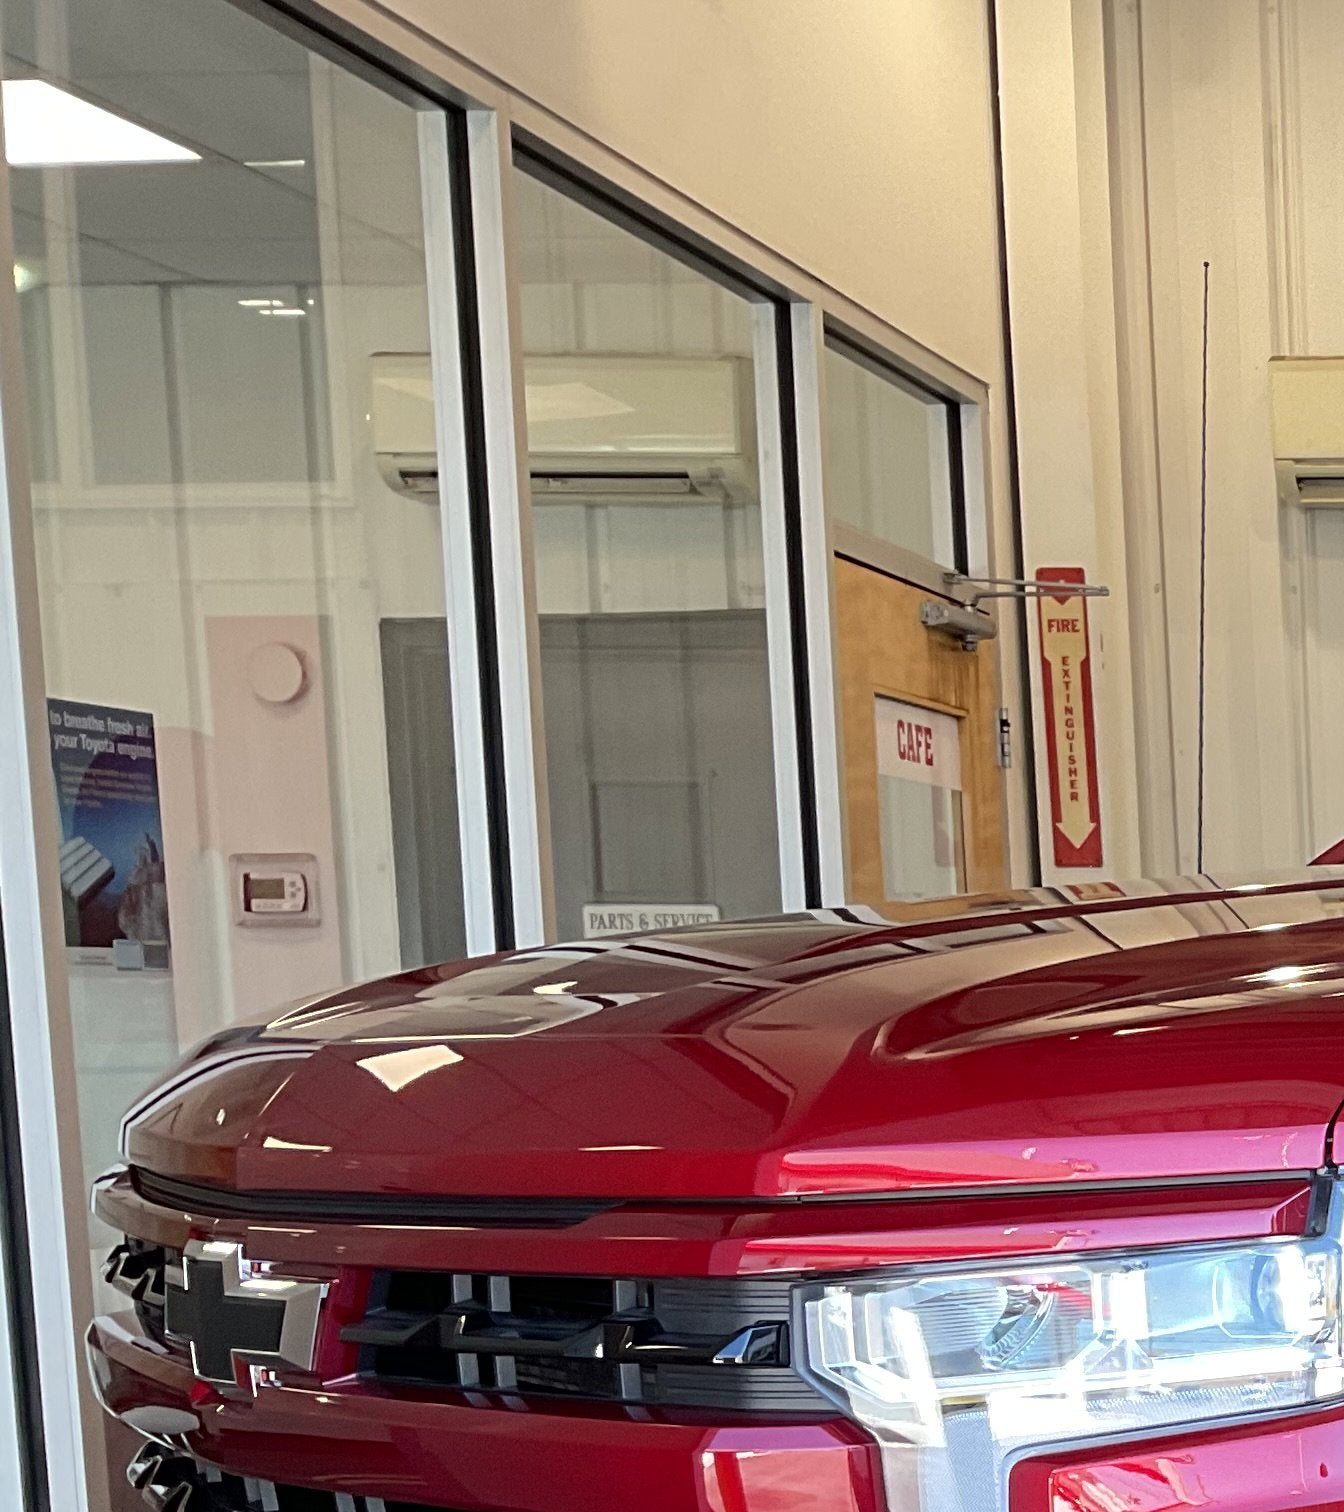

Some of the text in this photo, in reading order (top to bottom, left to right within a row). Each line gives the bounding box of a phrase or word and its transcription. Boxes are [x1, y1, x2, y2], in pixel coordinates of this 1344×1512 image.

[1047, 618, 1081, 634] FIRE
[106, 717, 134, 736] fresh
[1061, 656, 1080, 802] EXTINGUISHER
[79, 733, 115, 756] Toyota
[897, 719, 934, 767] CAFE
[589, 912, 634, 931] PARTS
[638, 913, 650, 931] &
